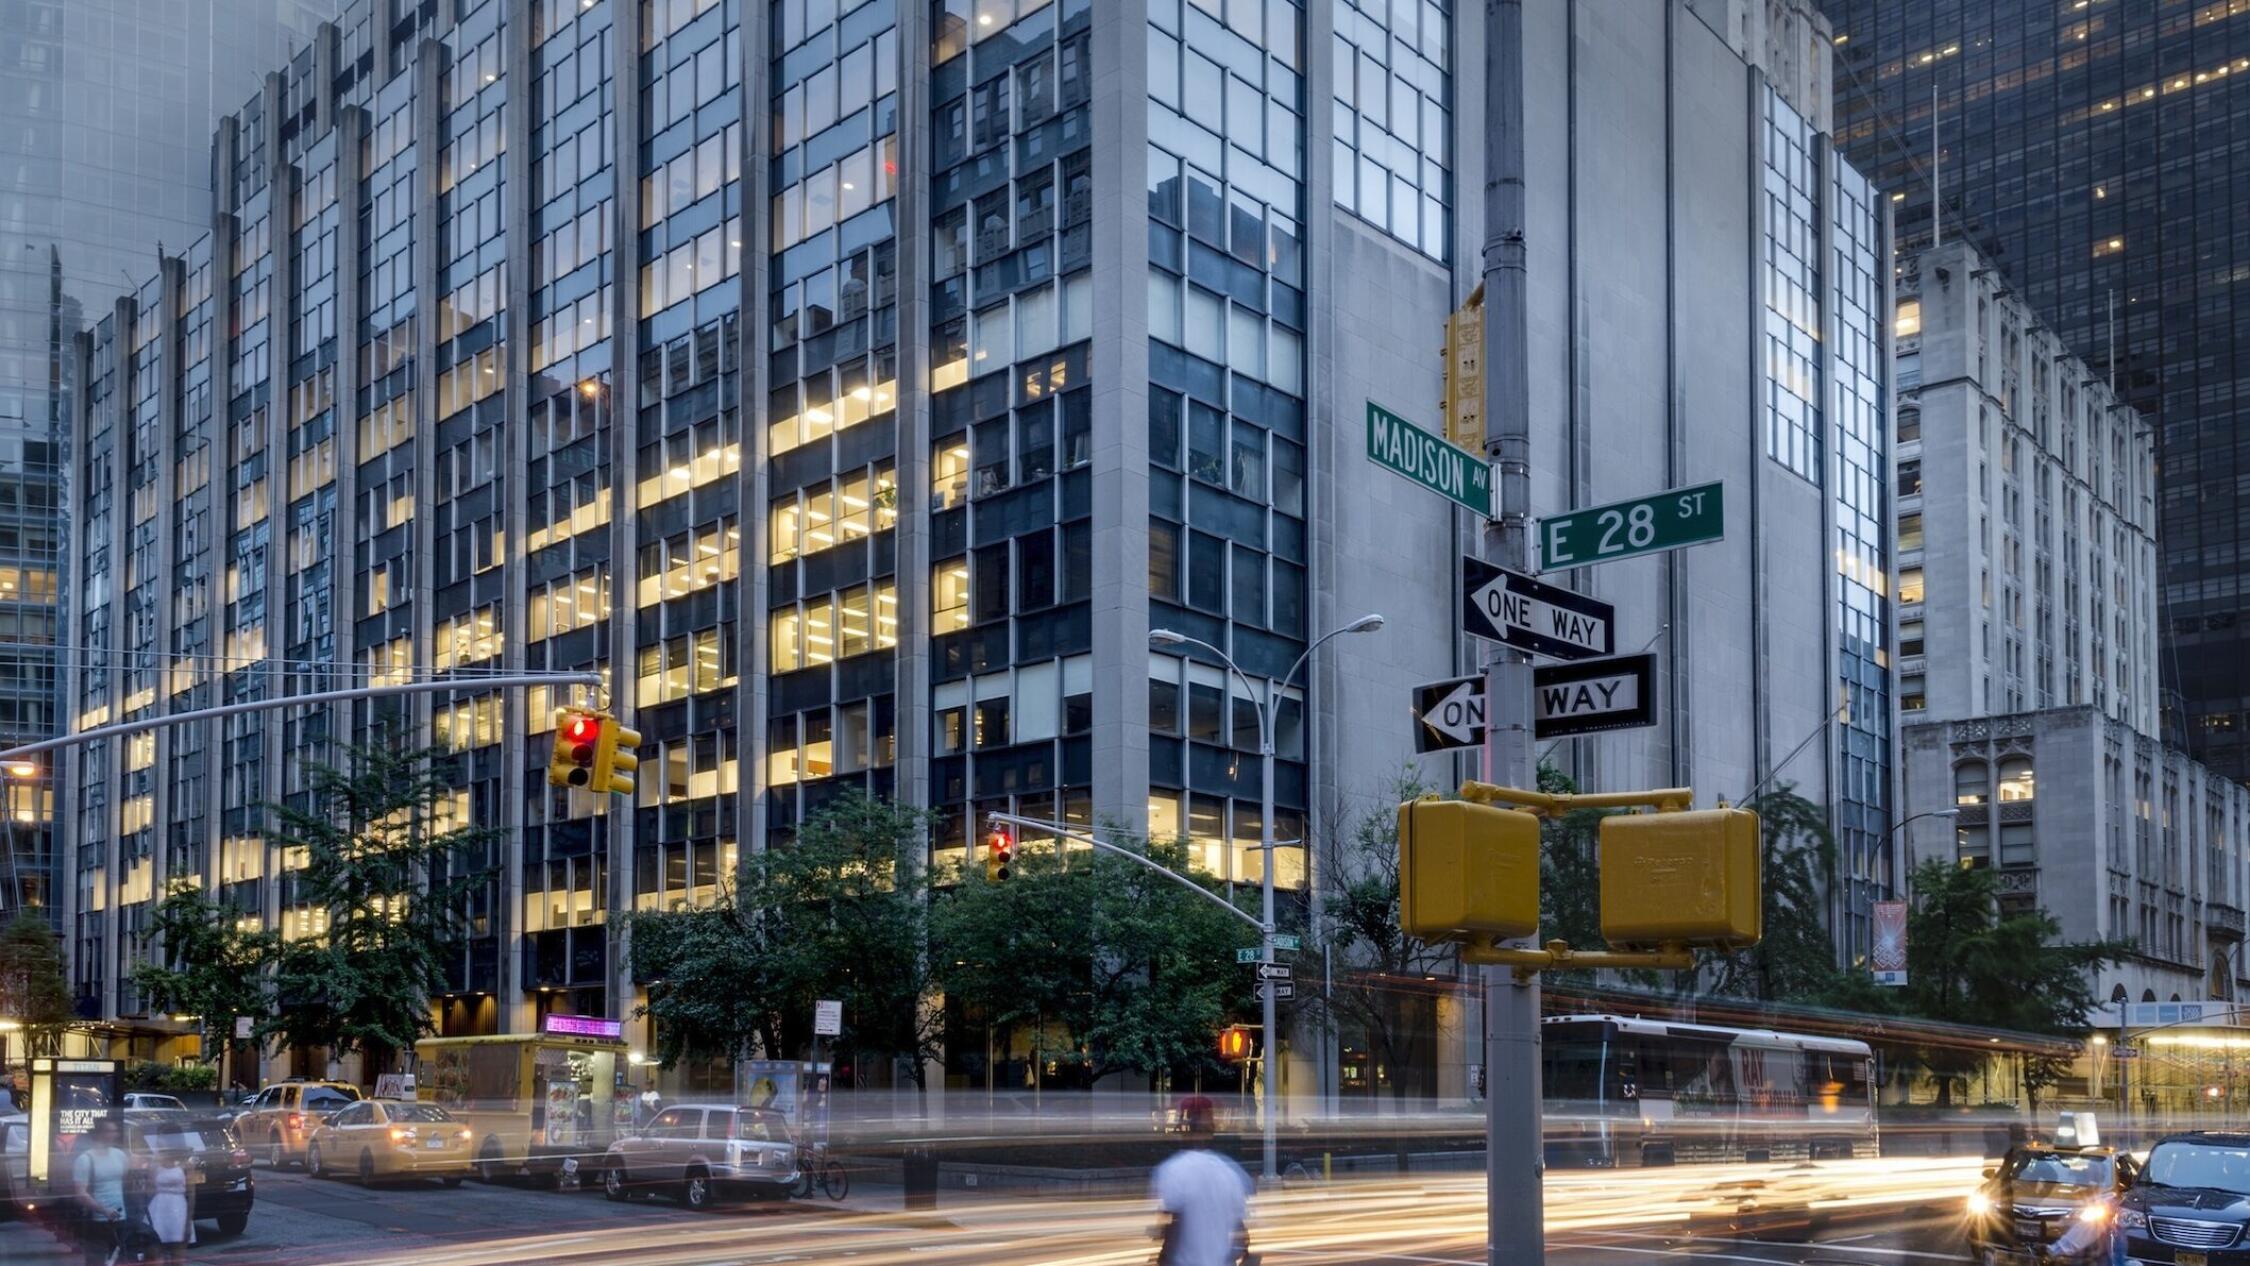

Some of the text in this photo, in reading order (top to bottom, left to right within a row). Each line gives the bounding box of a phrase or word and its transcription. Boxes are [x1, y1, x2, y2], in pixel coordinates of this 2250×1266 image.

[1373, 411, 1486, 499] MADISON AV
[1550, 492, 1706, 563] E 28 ST
[1488, 589, 1596, 646] ONE WAY
[1444, 680, 1620, 728] ON WAY
[1245, 949, 1255, 960] 28
[1741, 1049, 1763, 1088] RAY
[60, 1109, 108, 1118] THE CITY THAT
